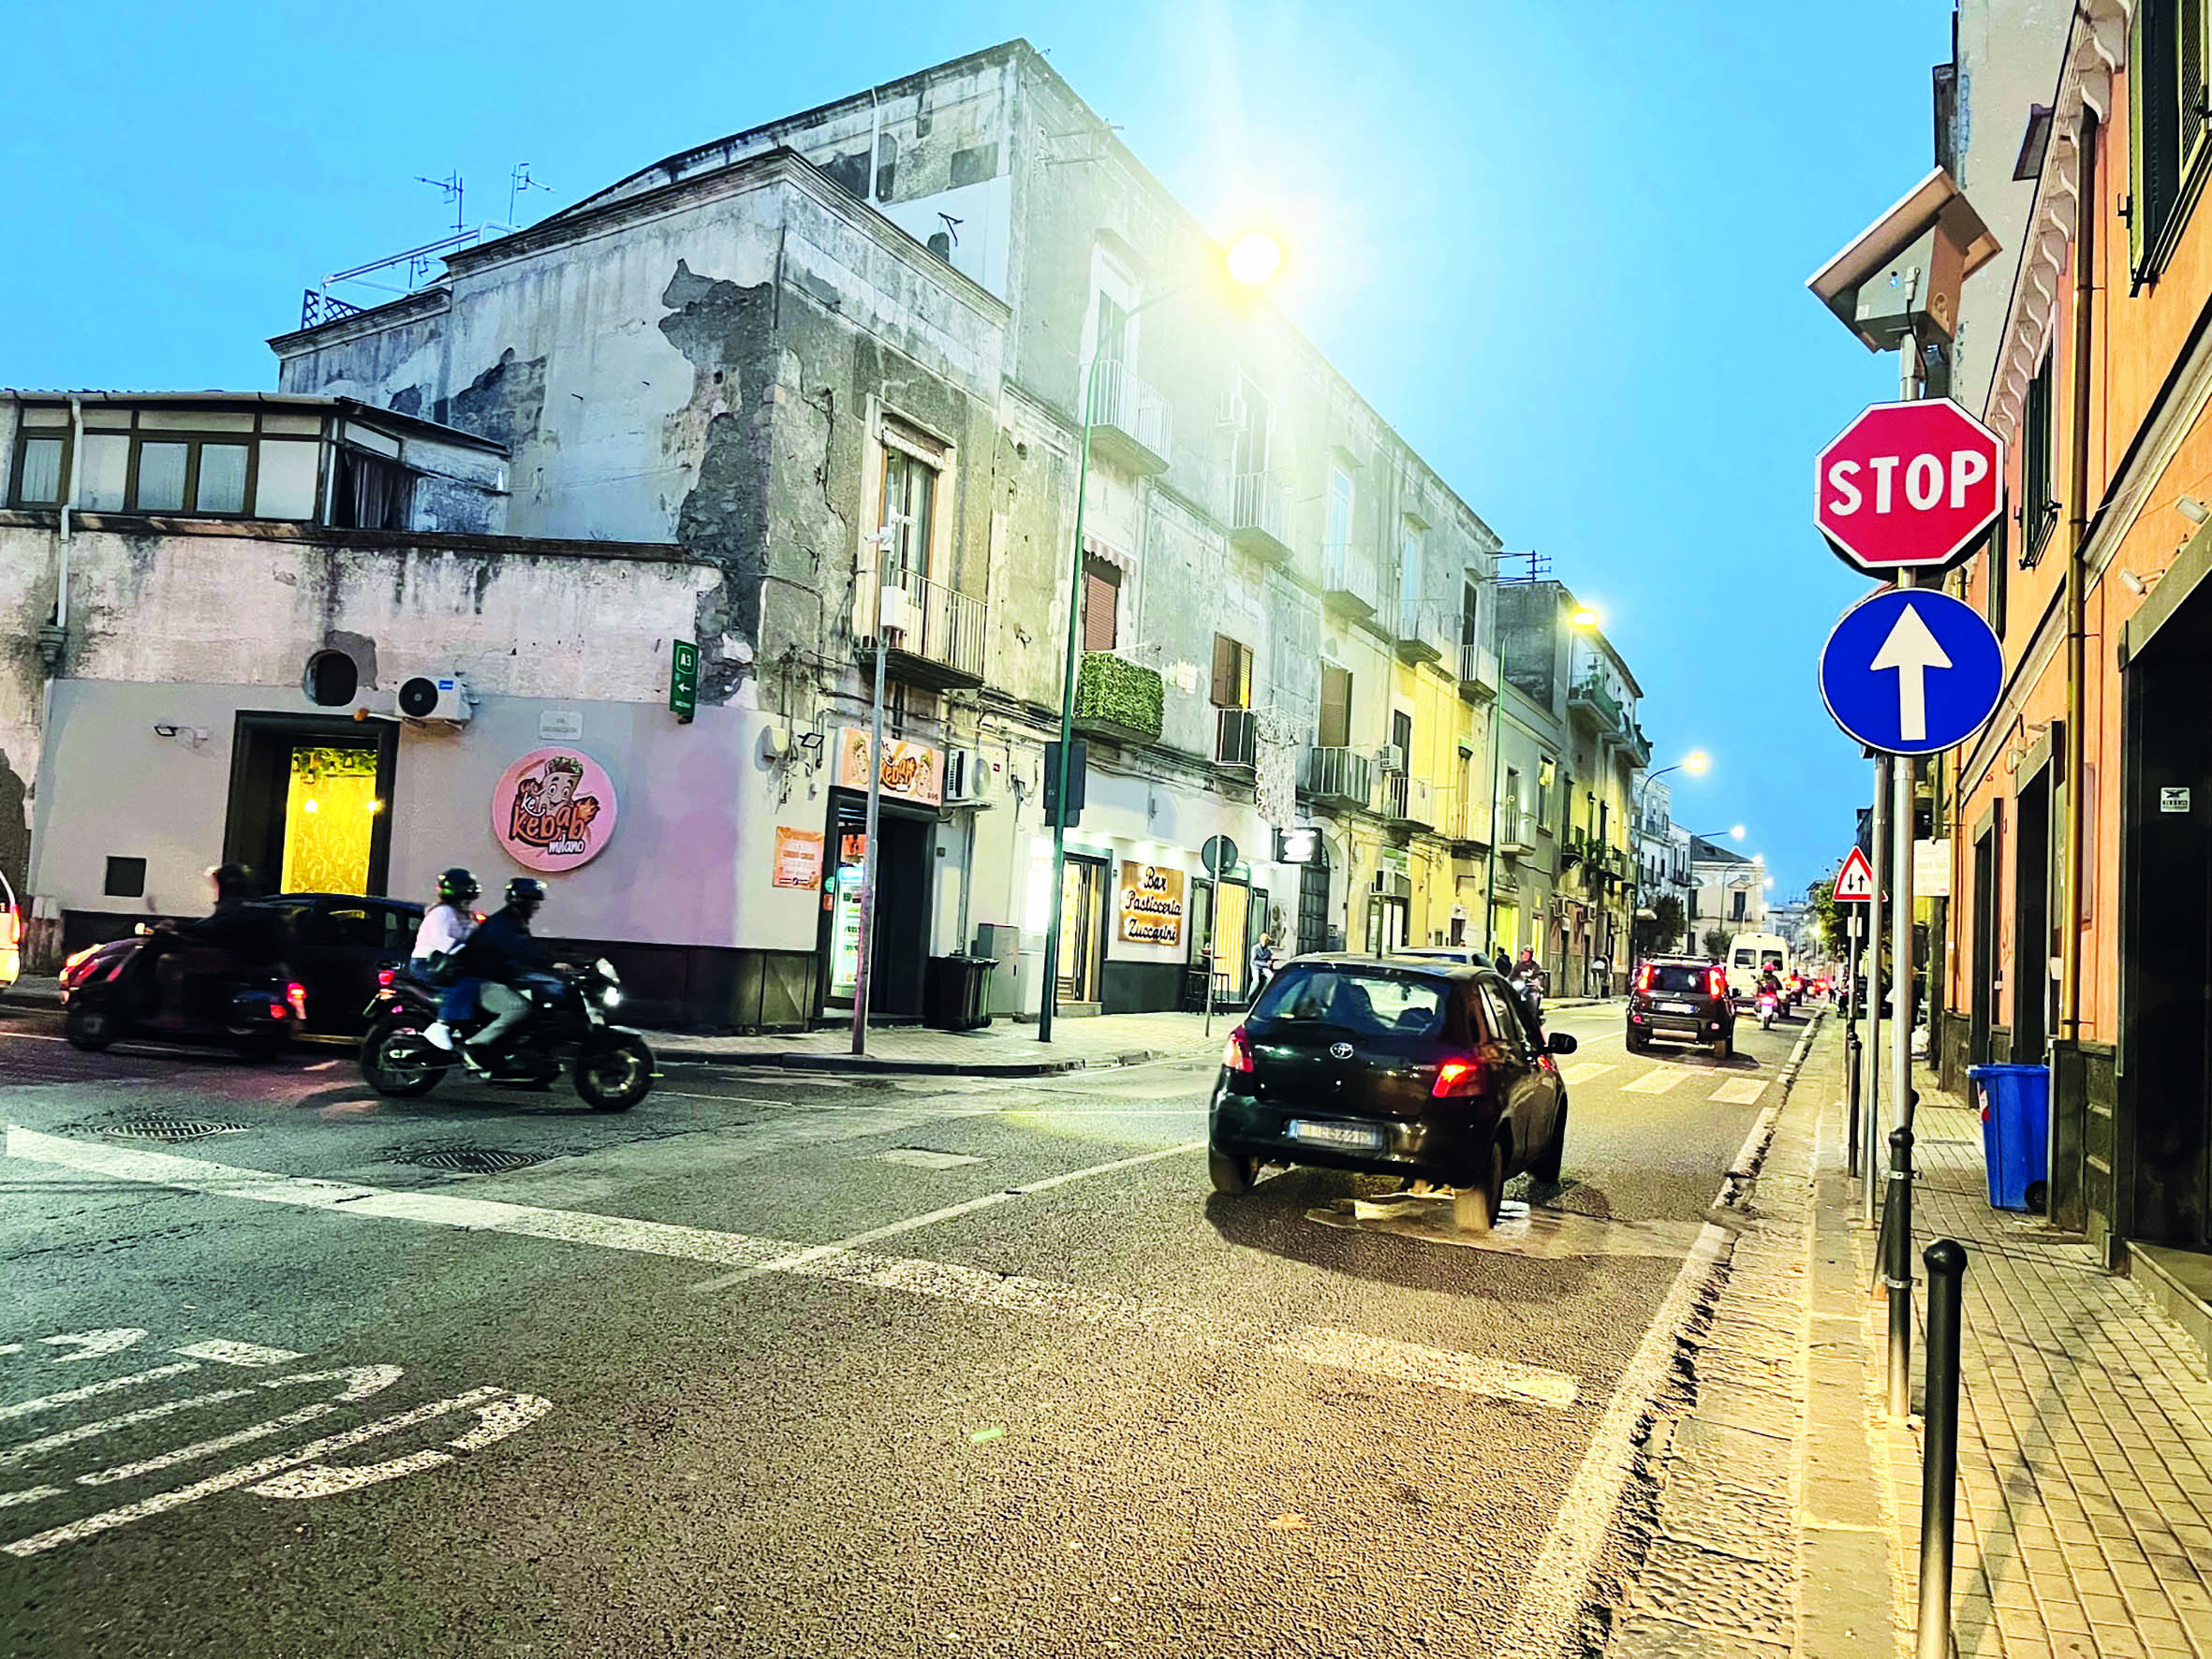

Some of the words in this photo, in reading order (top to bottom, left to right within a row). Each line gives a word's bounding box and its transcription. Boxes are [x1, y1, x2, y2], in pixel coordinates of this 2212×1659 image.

[1828, 449, 1988, 516] STOP
[680, 653, 692, 667] A3
[1143, 866, 1167, 891] Bar
[1125, 889, 1182, 917] Pasticceria
[1128, 918, 1177, 942] Zuccarini
